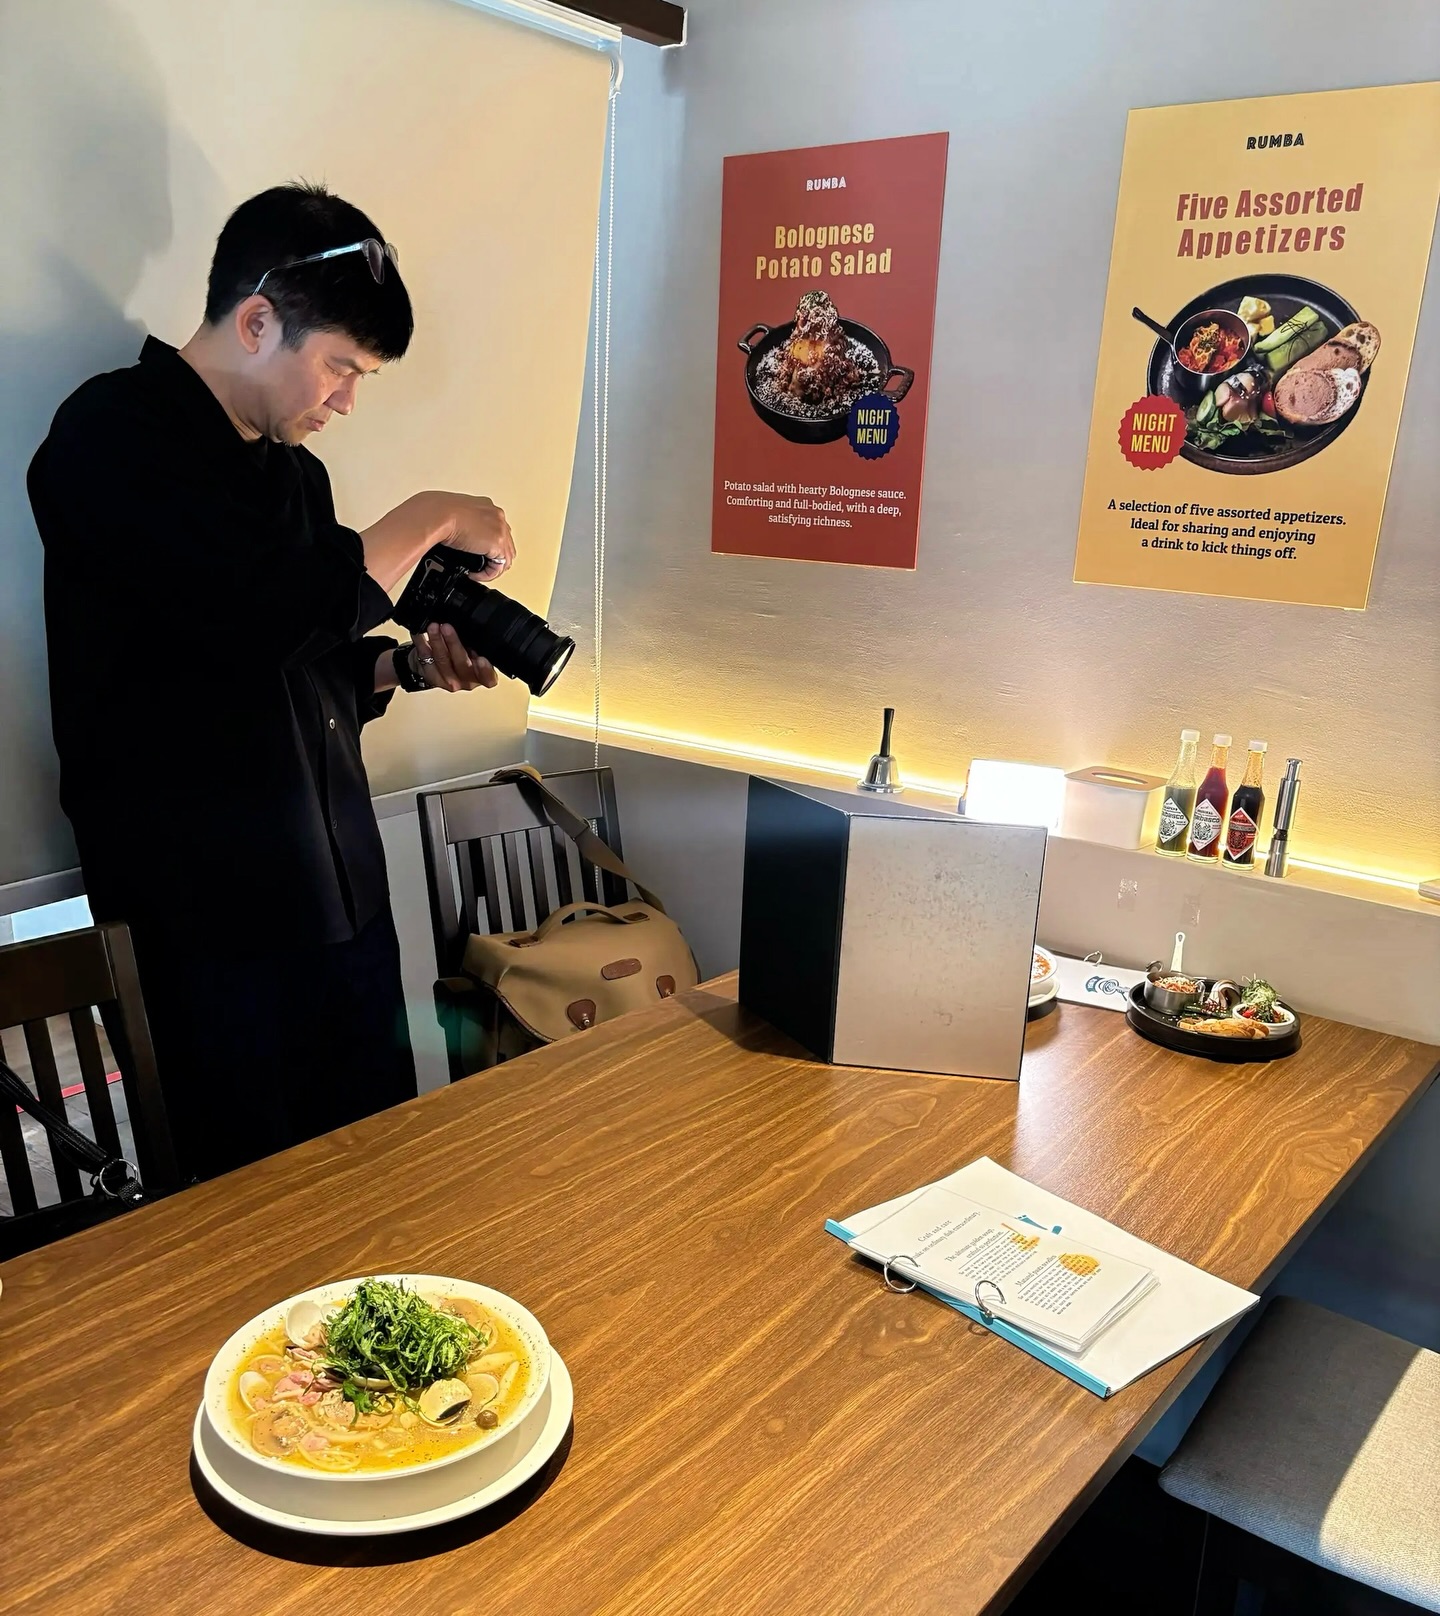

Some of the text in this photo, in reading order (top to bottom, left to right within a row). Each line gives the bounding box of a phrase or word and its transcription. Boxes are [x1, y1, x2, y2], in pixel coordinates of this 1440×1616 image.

[1246, 133, 1304, 150] RUMBA
[806, 176, 846, 192] RUMBA
[1176, 183, 1364, 221] Five Assorted
[774, 223, 875, 249] Bolognese
[1177, 224, 1346, 259] Appetizers
[756, 248, 892, 280] Potato Salad
[858, 409, 891, 426] NIGHT
[1132, 413, 1177, 432] NIGHT
[857, 428, 888, 444] MENU
[1131, 434, 1170, 454] MENU
[724, 480, 906, 500] Potato salad with hearty Bolognese sauce.
[726, 496, 902, 518] Comforting and full-bodied, with a deep,
[1108, 498, 1346, 526] A selection of five assorted appetizers.
[768, 514, 852, 528] satisfying richness.
[1130, 518, 1316, 544] Ideal for sharing and enjoying
[1142, 537, 1297, 560] a drink to kick things off.
[918, 1231, 933, 1242] Craft
[932, 1226, 942, 1234] and
